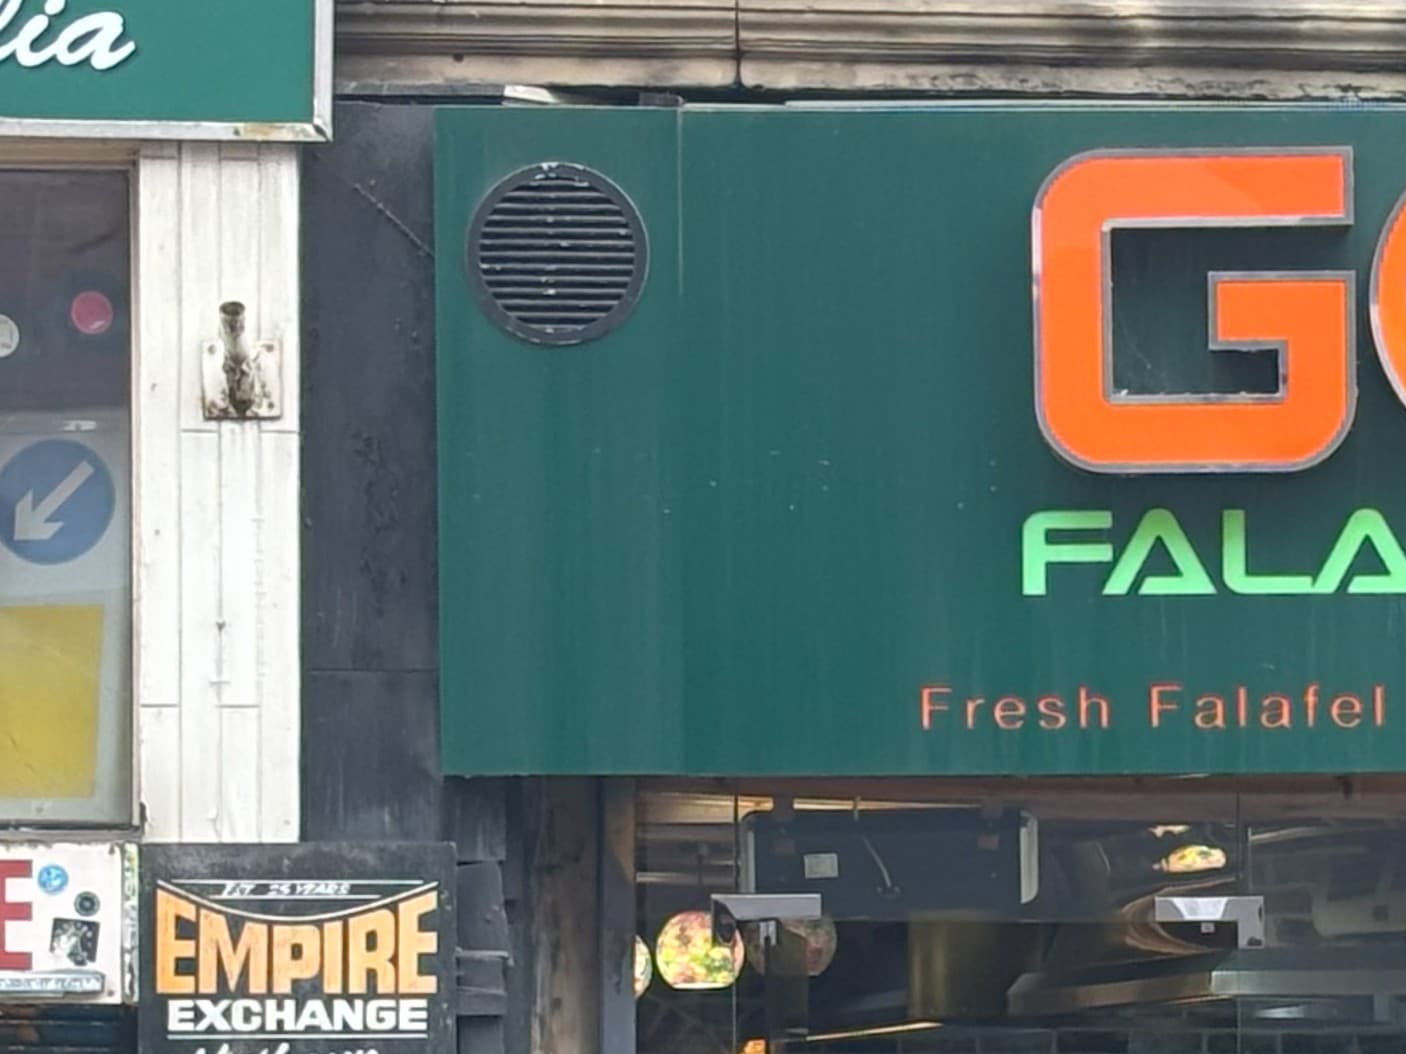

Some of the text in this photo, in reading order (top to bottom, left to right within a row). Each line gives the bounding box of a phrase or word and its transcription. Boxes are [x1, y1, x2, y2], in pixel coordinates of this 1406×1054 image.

[919, 684, 1111, 730] Fresh
[1148, 682, 1386, 729] Falafel
[155, 887, 438, 995] EMPIRE
[167, 999, 428, 1032] EXCHANGE
